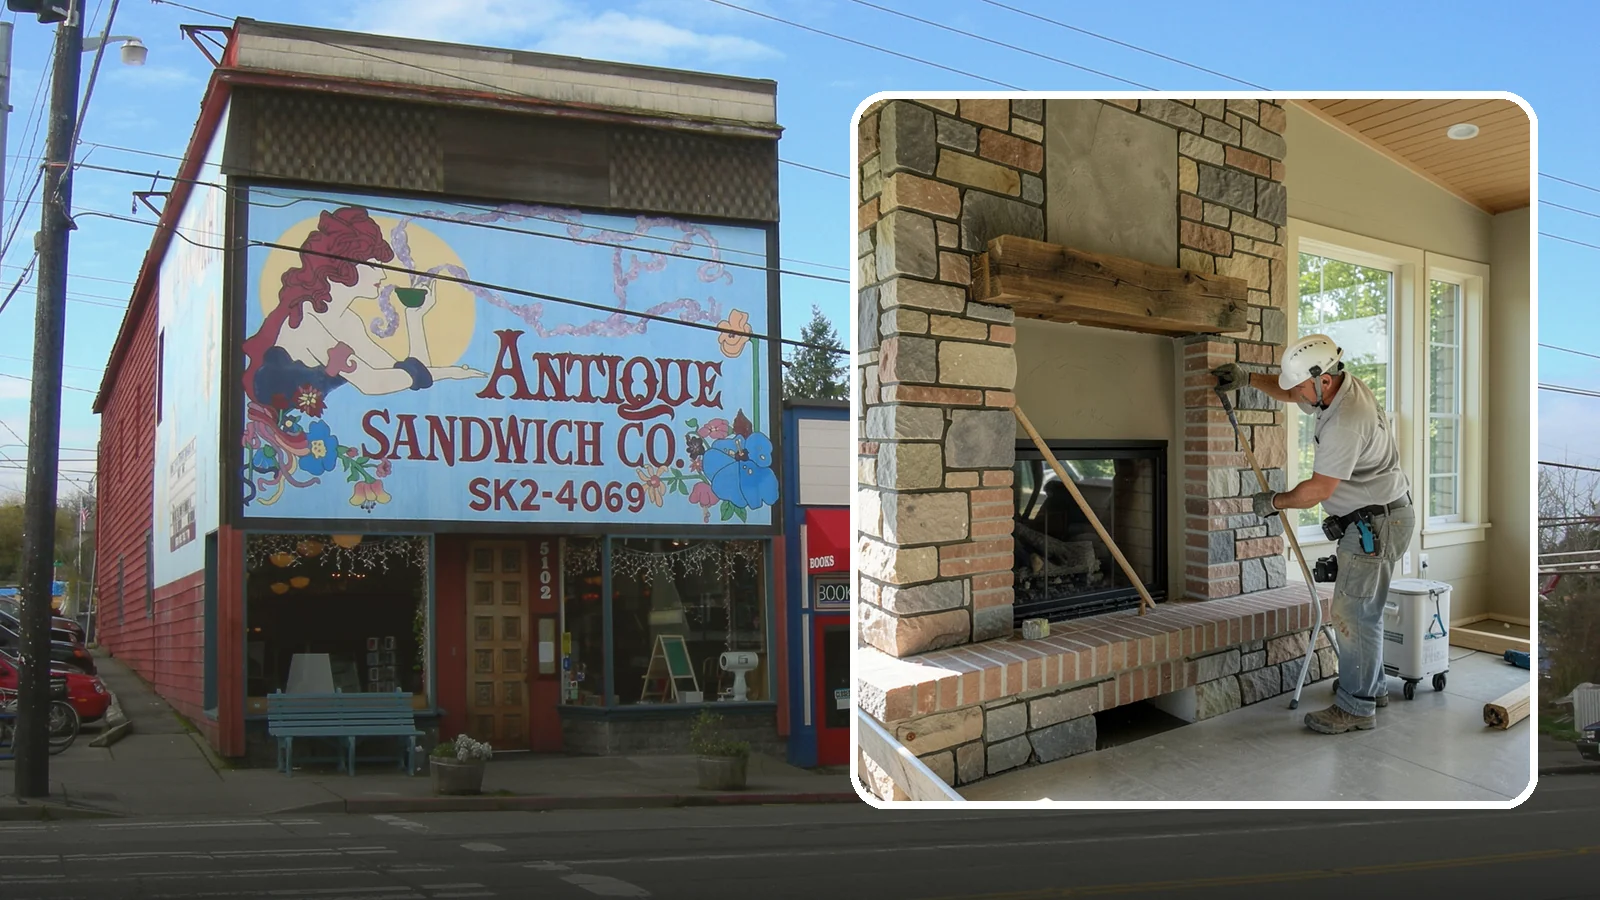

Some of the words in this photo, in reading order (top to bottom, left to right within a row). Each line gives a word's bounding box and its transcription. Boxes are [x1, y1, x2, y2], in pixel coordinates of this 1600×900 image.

[477, 330, 723, 420] ANTIQUE
[361, 408, 604, 467] SANDWICH
[617, 420, 686, 469] CO.
[468, 476, 646, 513] SK2-4069
[539, 541, 552, 600] 5102
[809, 554, 835, 569] BOOKS
